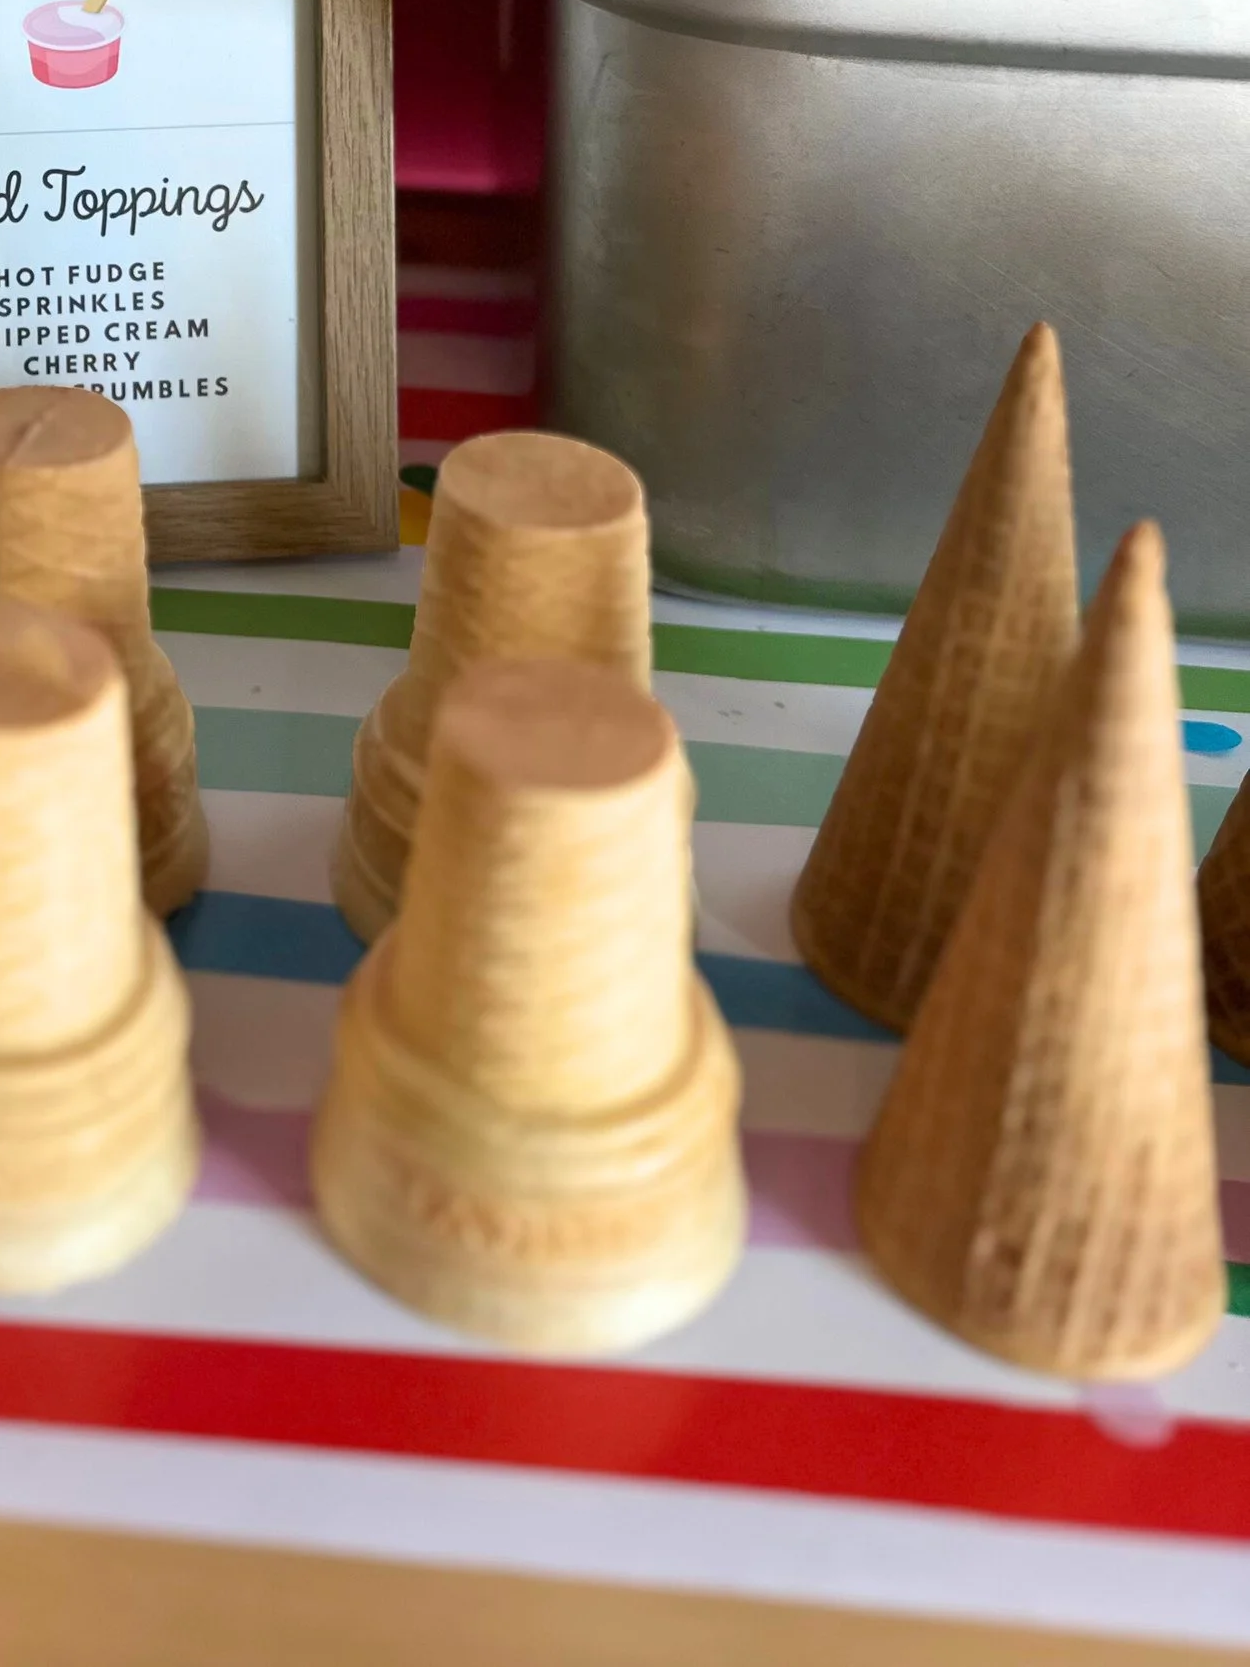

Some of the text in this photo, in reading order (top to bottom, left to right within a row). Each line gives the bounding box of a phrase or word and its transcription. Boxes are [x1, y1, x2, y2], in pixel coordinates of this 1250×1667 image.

[41, 164, 265, 237] Toppings
[67, 261, 166, 286] FUDGE
[103, 318, 210, 343] CREAM
[22, 351, 141, 377] CHERRY
